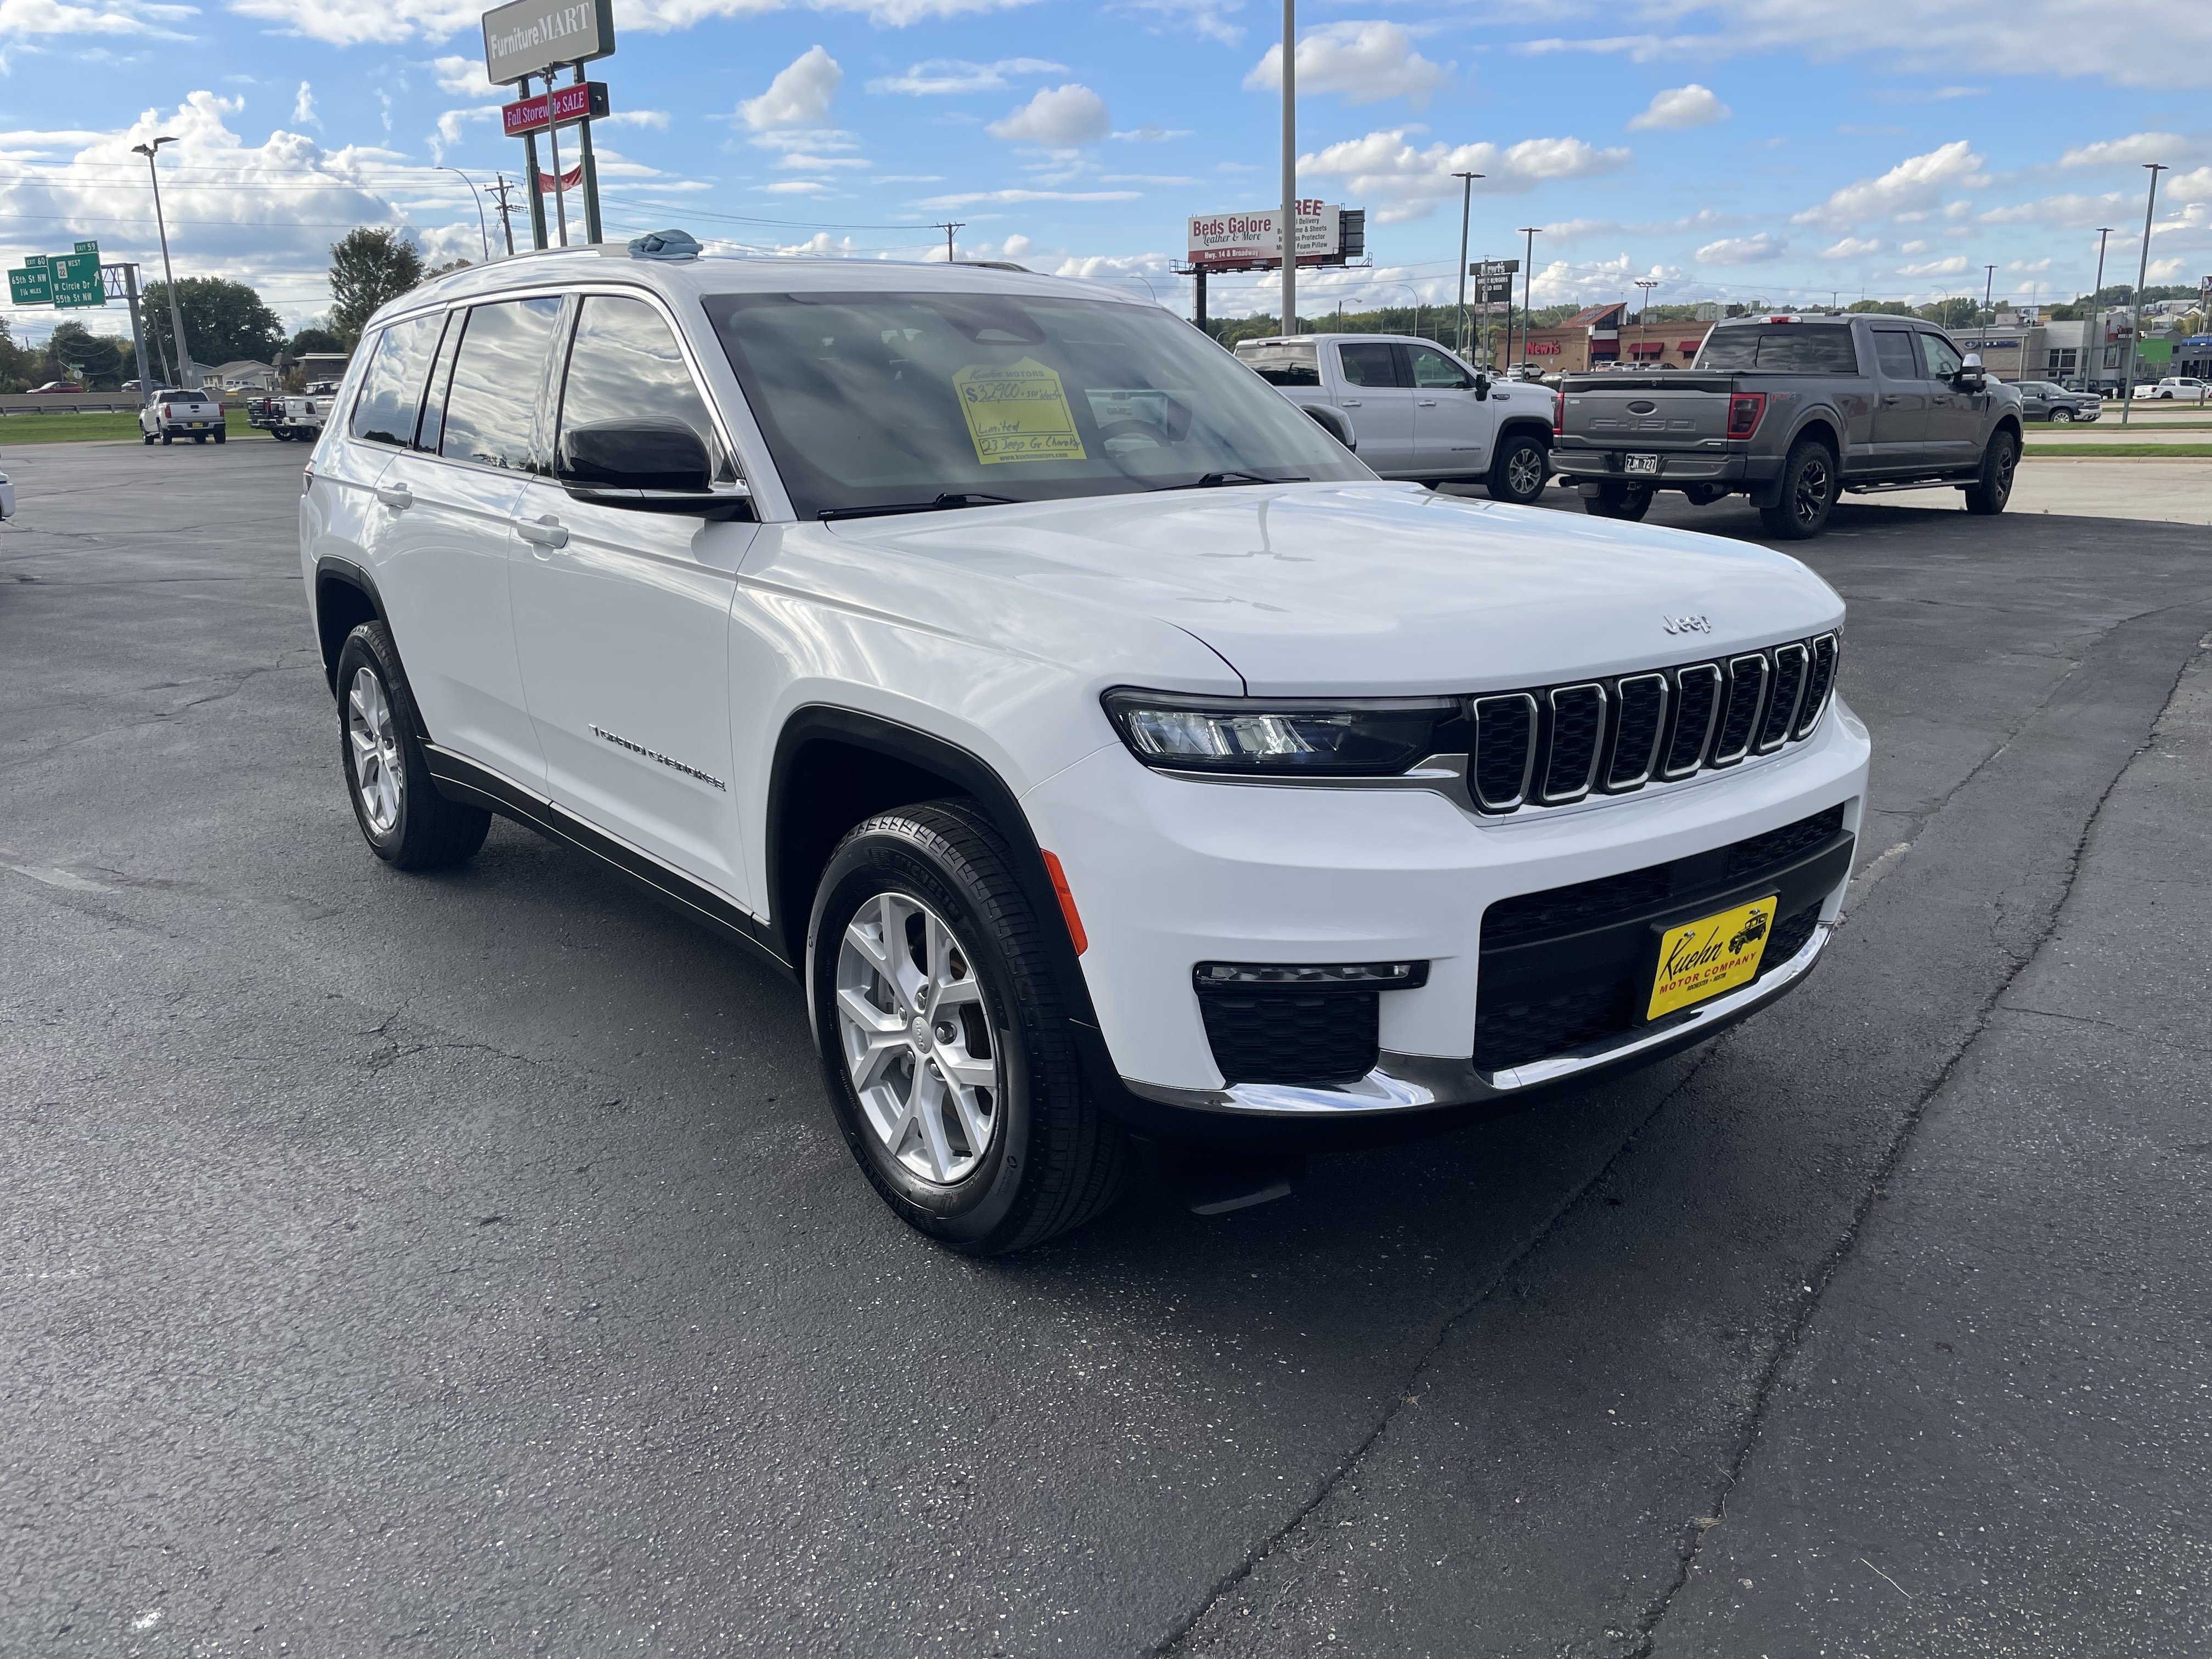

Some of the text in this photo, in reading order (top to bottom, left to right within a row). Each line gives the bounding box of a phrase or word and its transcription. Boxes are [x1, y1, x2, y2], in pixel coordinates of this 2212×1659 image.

[490, 2, 590, 59] FurnitureMART
[507, 92, 584, 127] Fall Storewde SALE
[1295, 199, 1323, 216] REE
[1193, 216, 1271, 236] Beds Galore
[1203, 231, 1261, 246] Leather & More
[87, 242, 95, 251] 59
[1232, 249, 1259, 258] Broadway
[37, 257, 46, 265] 60
[67, 259, 81, 267] WEST
[59, 268, 66, 276] 22
[12, 274, 47, 285] 65th St NW
[61, 282, 80, 291] Circle
[82, 281, 90, 289] Dr
[56, 292, 92, 303] 55th St NW
[1526, 340, 1560, 355] Newt's
[1771, 392, 1796, 403] FX4
[979, 420, 1020, 434] Limited
[1588, 417, 1696, 431] F-150
[1002, 437, 1025, 452] Jeep
[1030, 437, 1042, 449] Gr
[1627, 458, 1655, 469] ZJM 727
[1663, 613, 1712, 635] Jeep
[648, 749, 726, 792] CHEROKEE
[1658, 926, 1724, 981] Kuehn
[1659, 952, 1757, 995] MOTOR COMPANY
